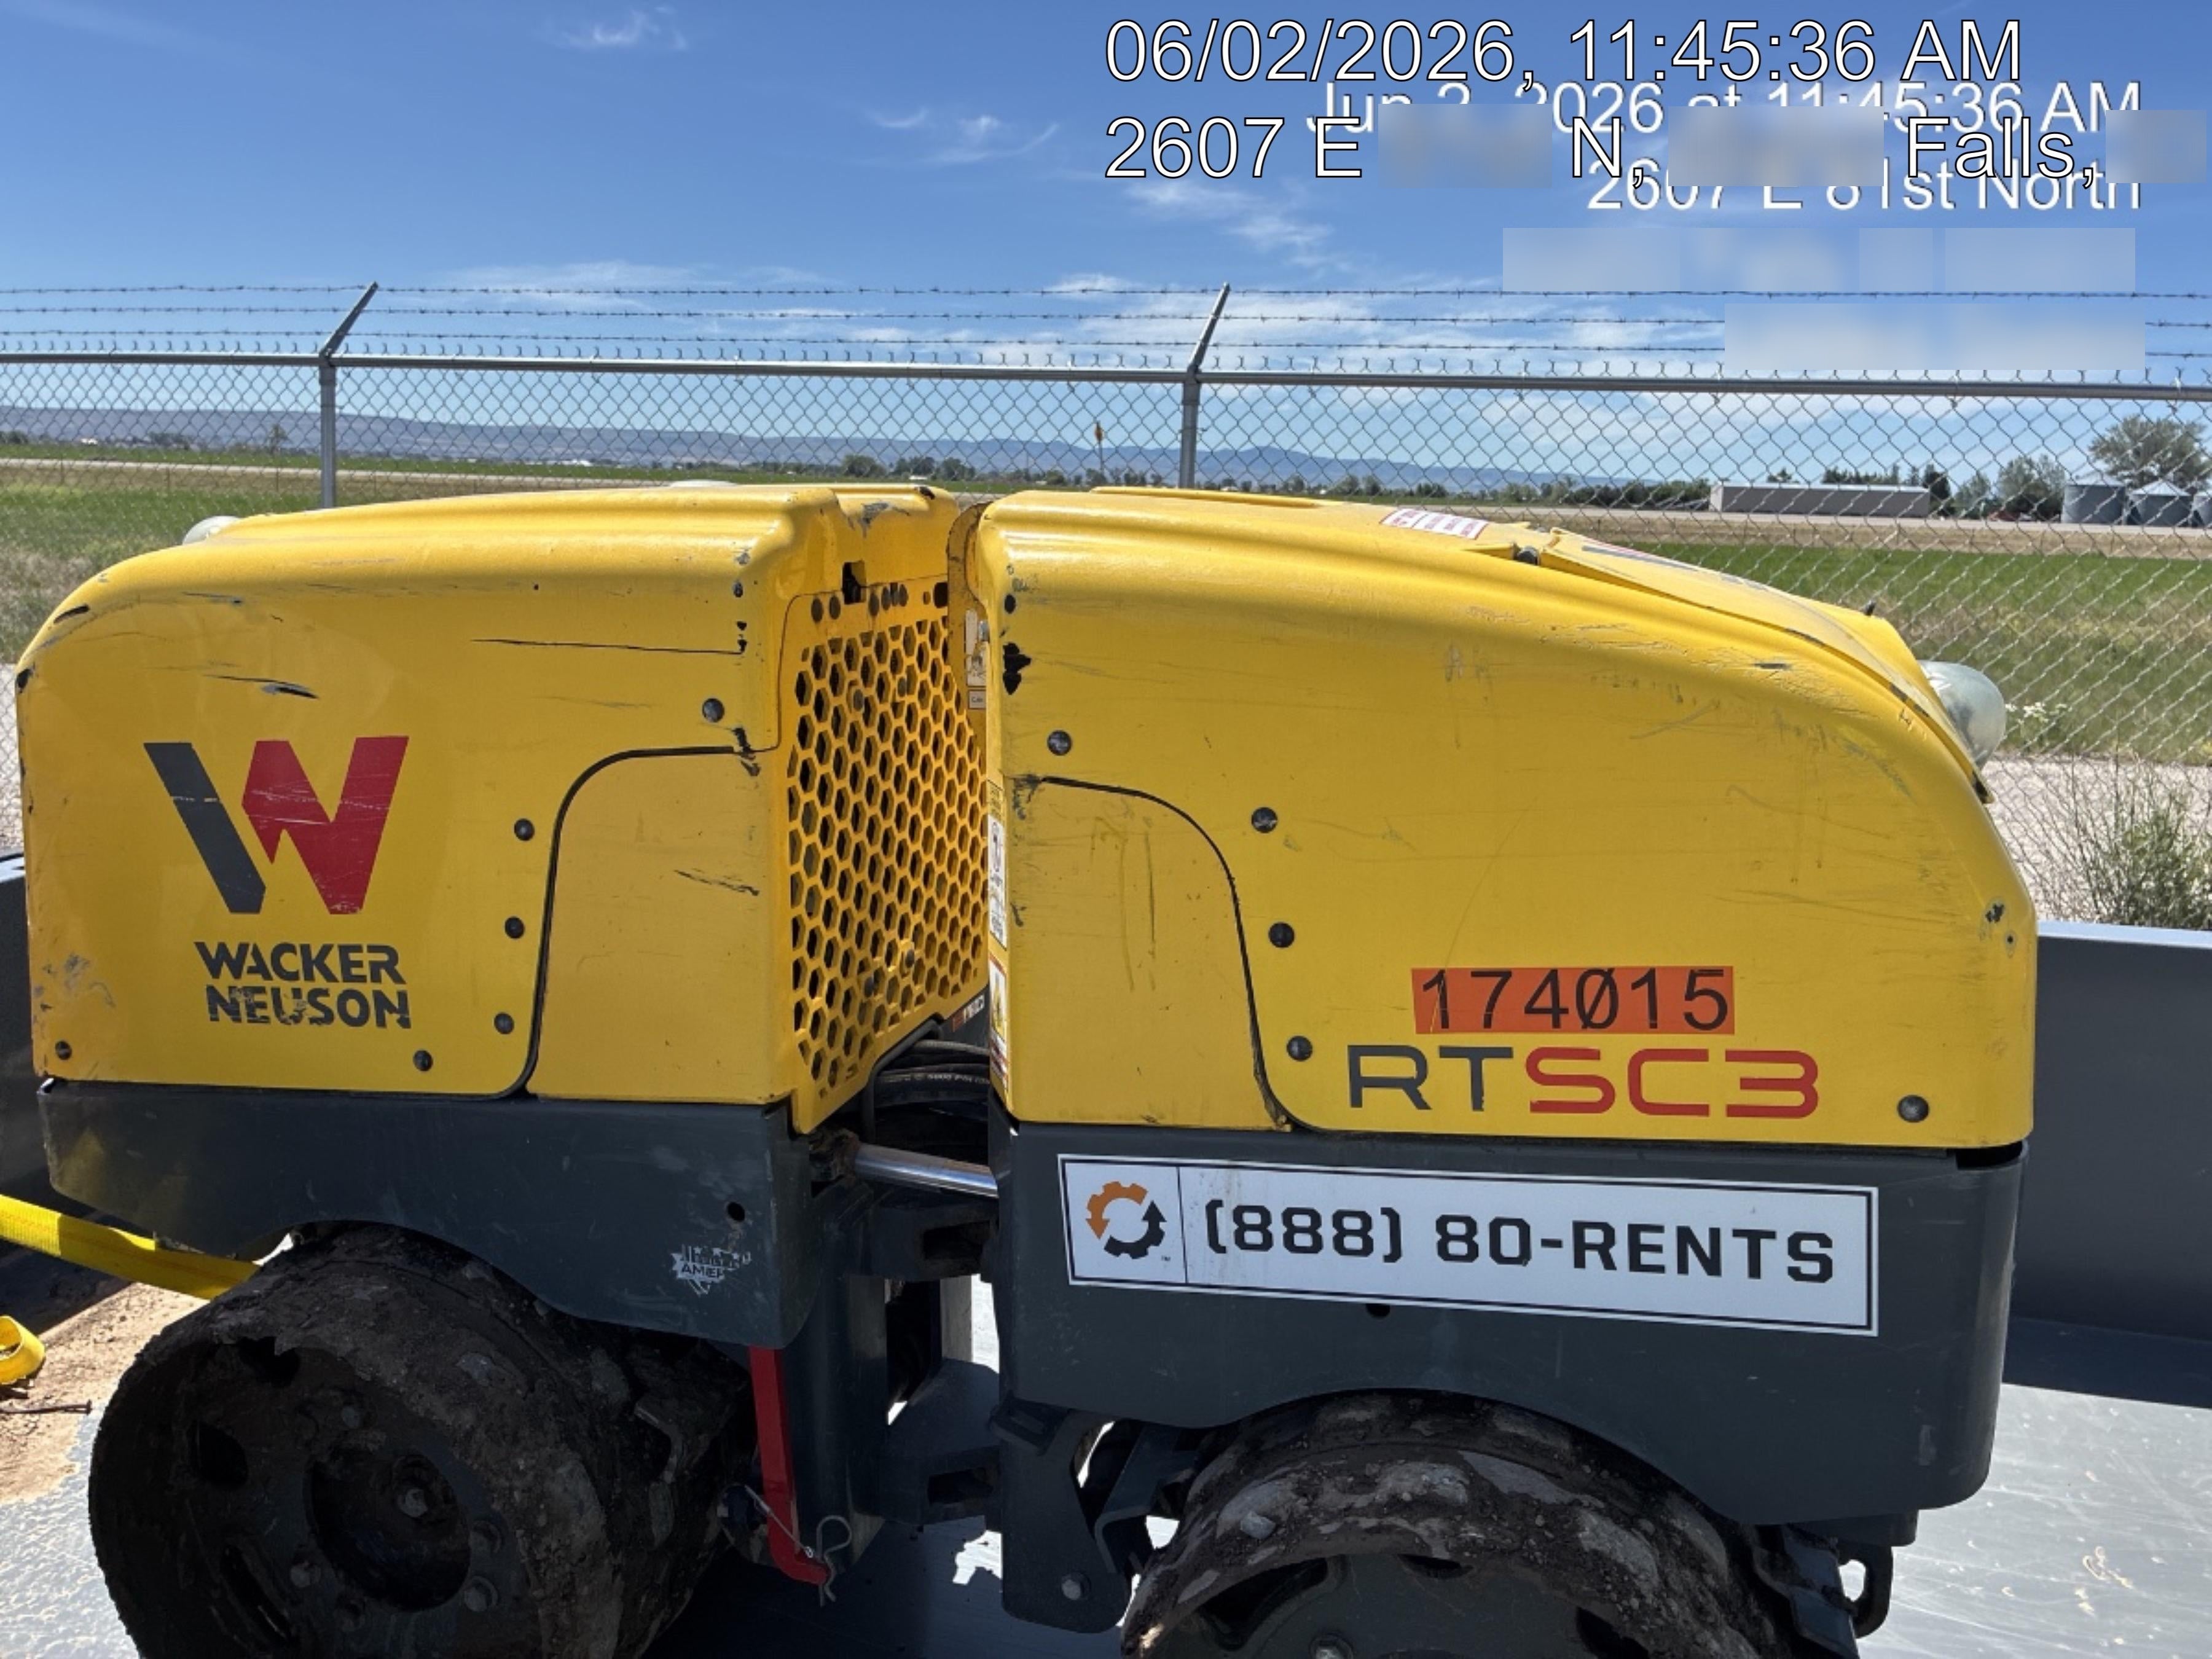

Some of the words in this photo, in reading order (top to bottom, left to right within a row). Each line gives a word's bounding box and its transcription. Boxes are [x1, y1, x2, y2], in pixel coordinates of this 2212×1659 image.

[194, 941, 407, 984] WACKER
[206, 984, 412, 1029] NEUSON
[1347, 1044, 1819, 1119] RTSC3
[1205, 1199, 1403, 1263] (888)
[1435, 1214, 1834, 1284] 80-RENTS
